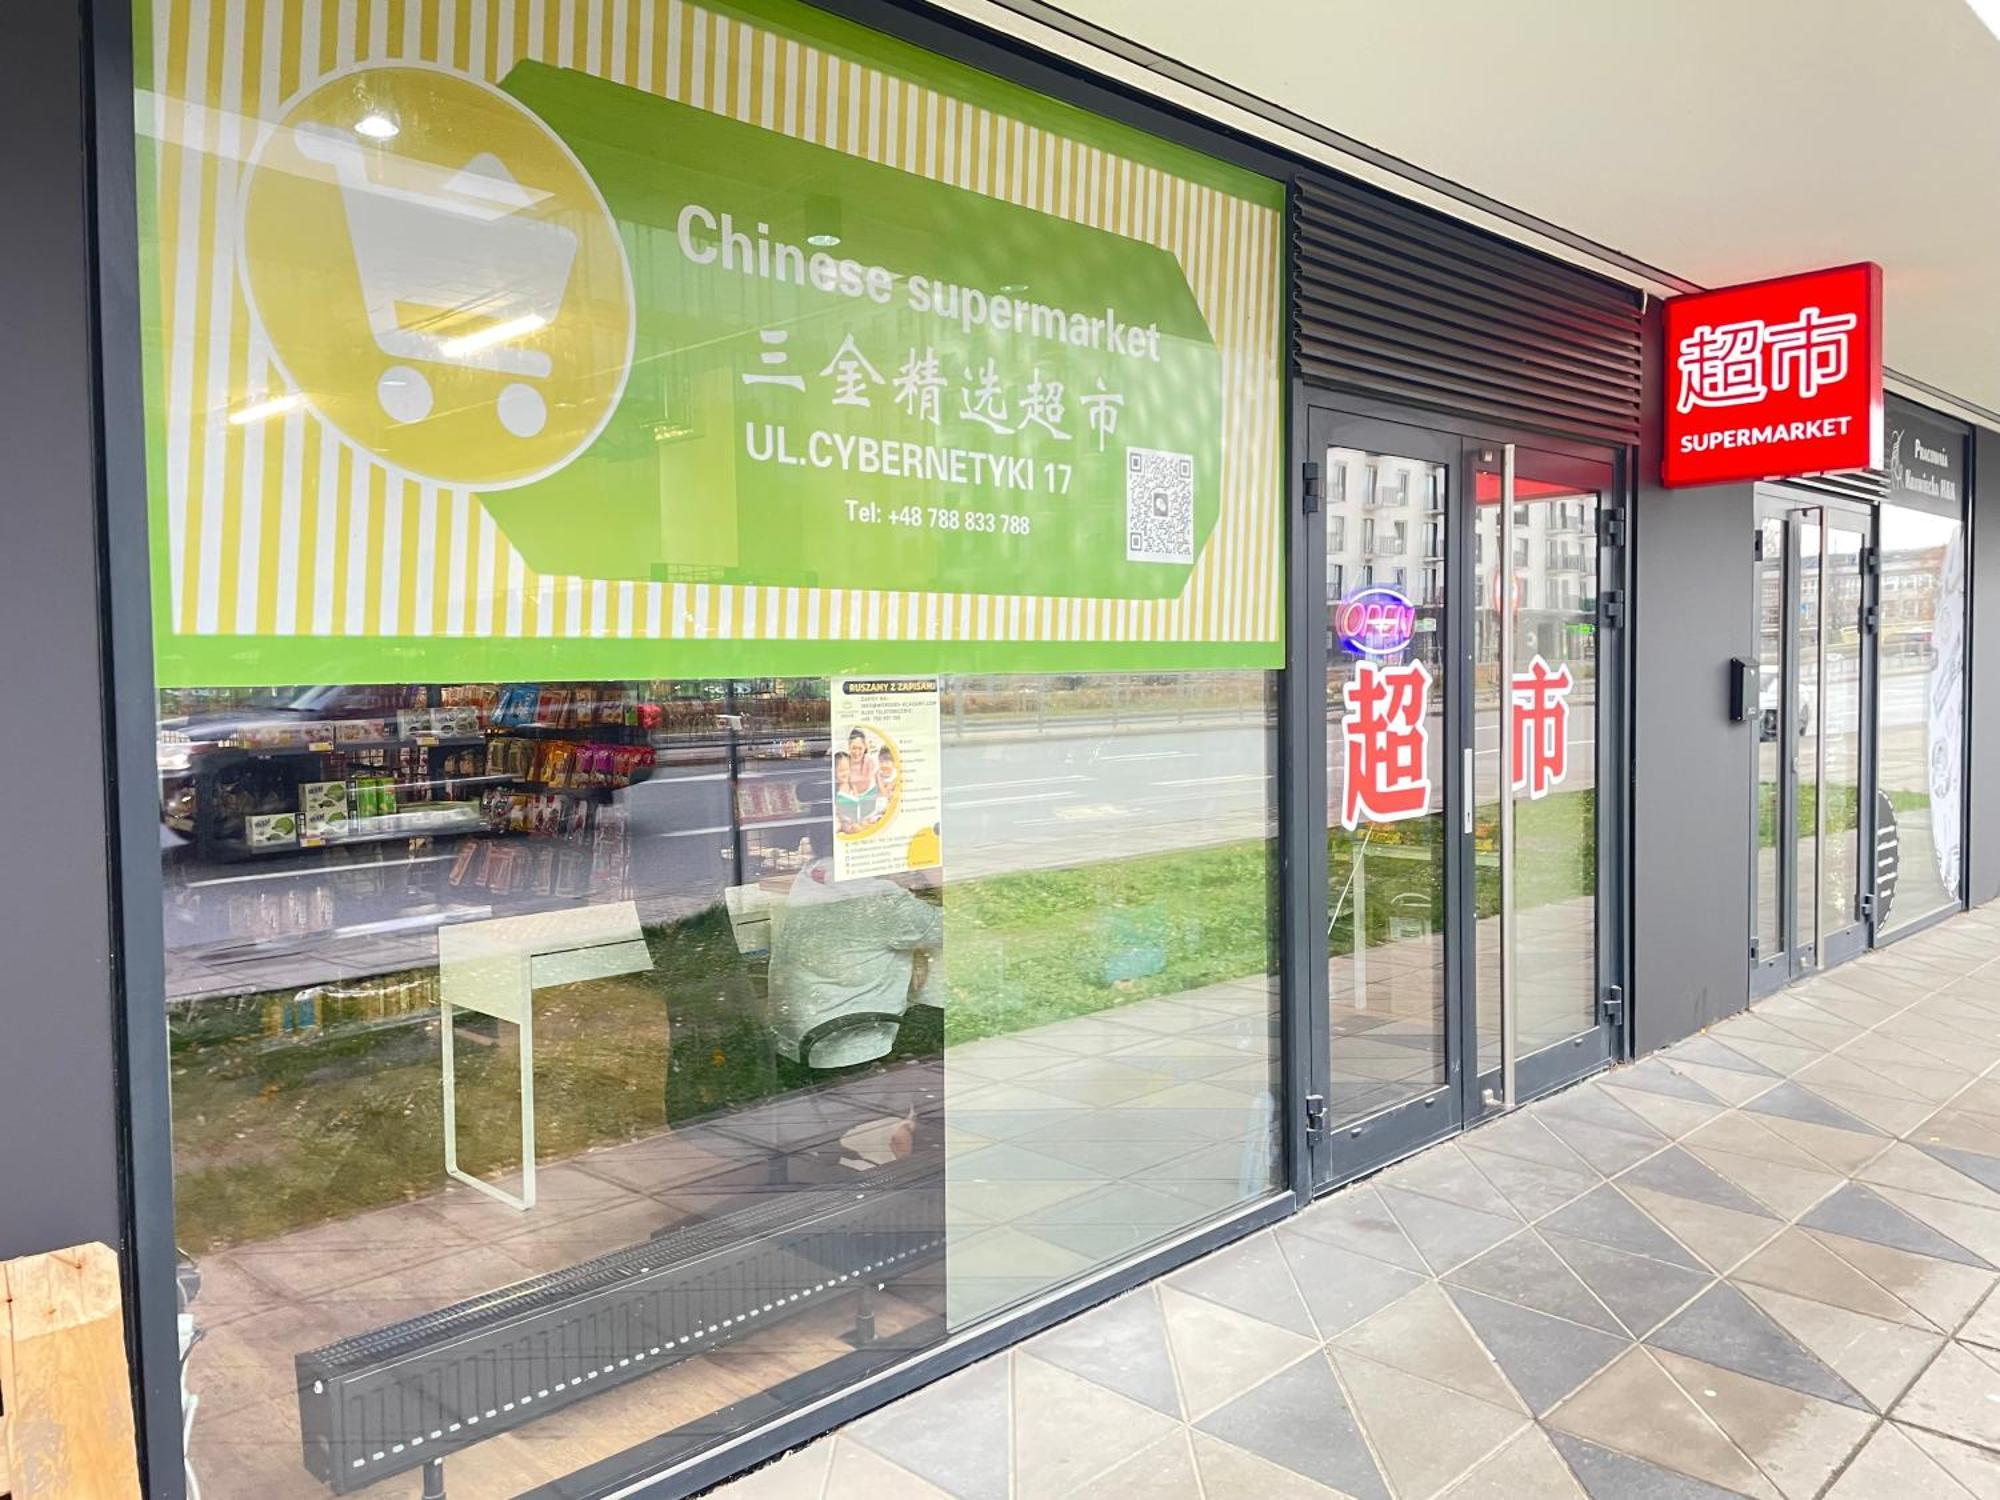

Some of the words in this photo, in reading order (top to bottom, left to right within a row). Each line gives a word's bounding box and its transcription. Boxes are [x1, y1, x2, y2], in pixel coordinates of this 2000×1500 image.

[677, 204, 895, 303] Chinese
[907, 275, 1161, 363] supermarket
[741, 329, 1125, 453] 三金精选超市
[1676, 306, 1857, 414] 超市
[746, 421, 1035, 492] UL.CYBERNETYKI
[1044, 463, 1072, 495] 17
[1680, 415, 1852, 453] SUPERMARKET
[845, 500, 882, 525] Tel:
[888, 506, 922, 529] +48
[928, 508, 960, 531] 788
[965, 511, 996, 533] 833
[1000, 514, 1031, 536] 788
[1342, 601, 1416, 639] OPEN
